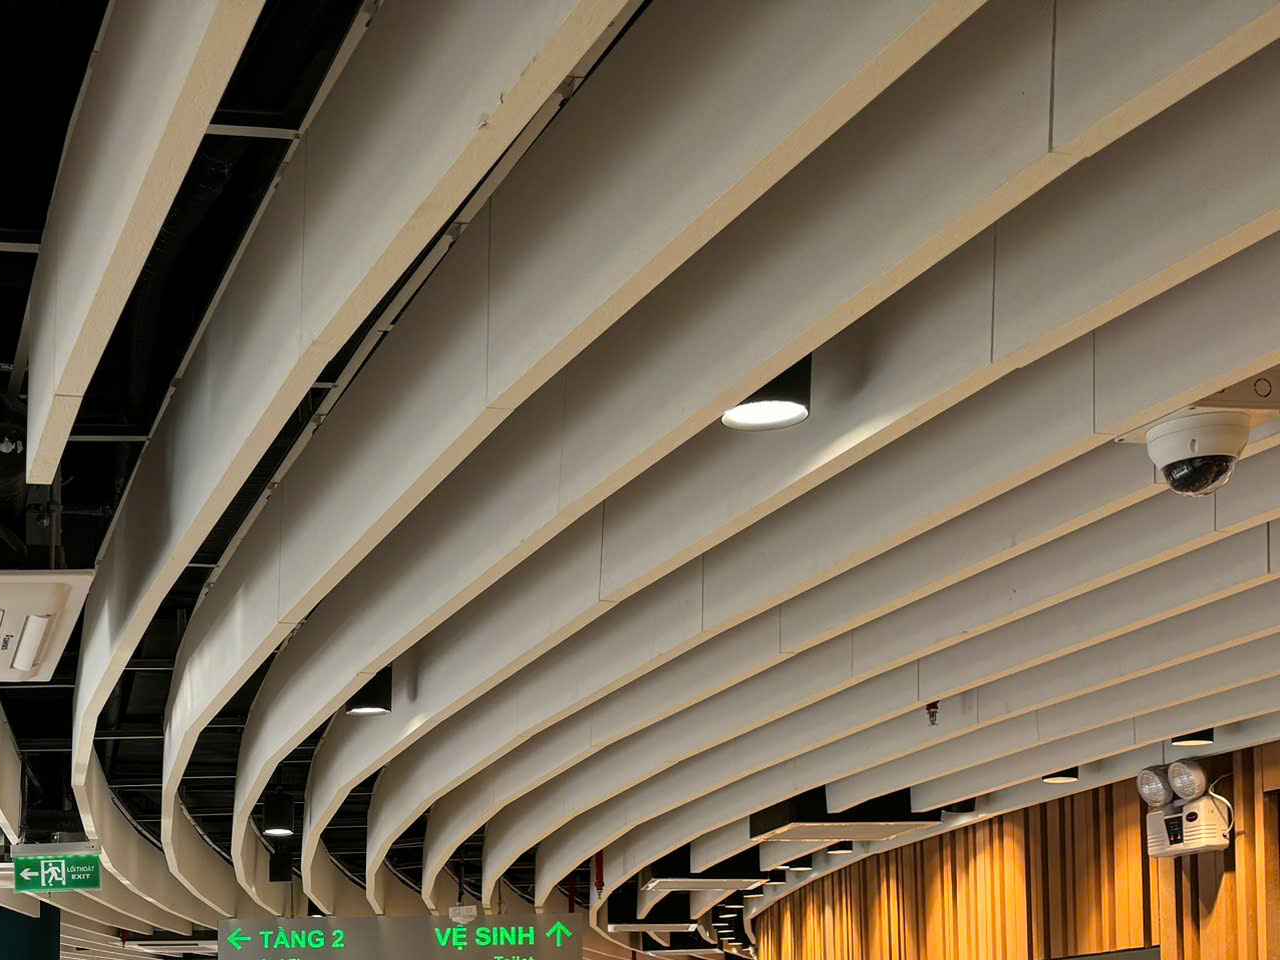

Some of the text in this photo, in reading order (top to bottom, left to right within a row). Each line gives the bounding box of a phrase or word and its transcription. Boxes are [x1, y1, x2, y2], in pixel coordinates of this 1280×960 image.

[259, 927, 345, 949] TẦNG 2
[434, 925, 535, 951] VỆ SINH
